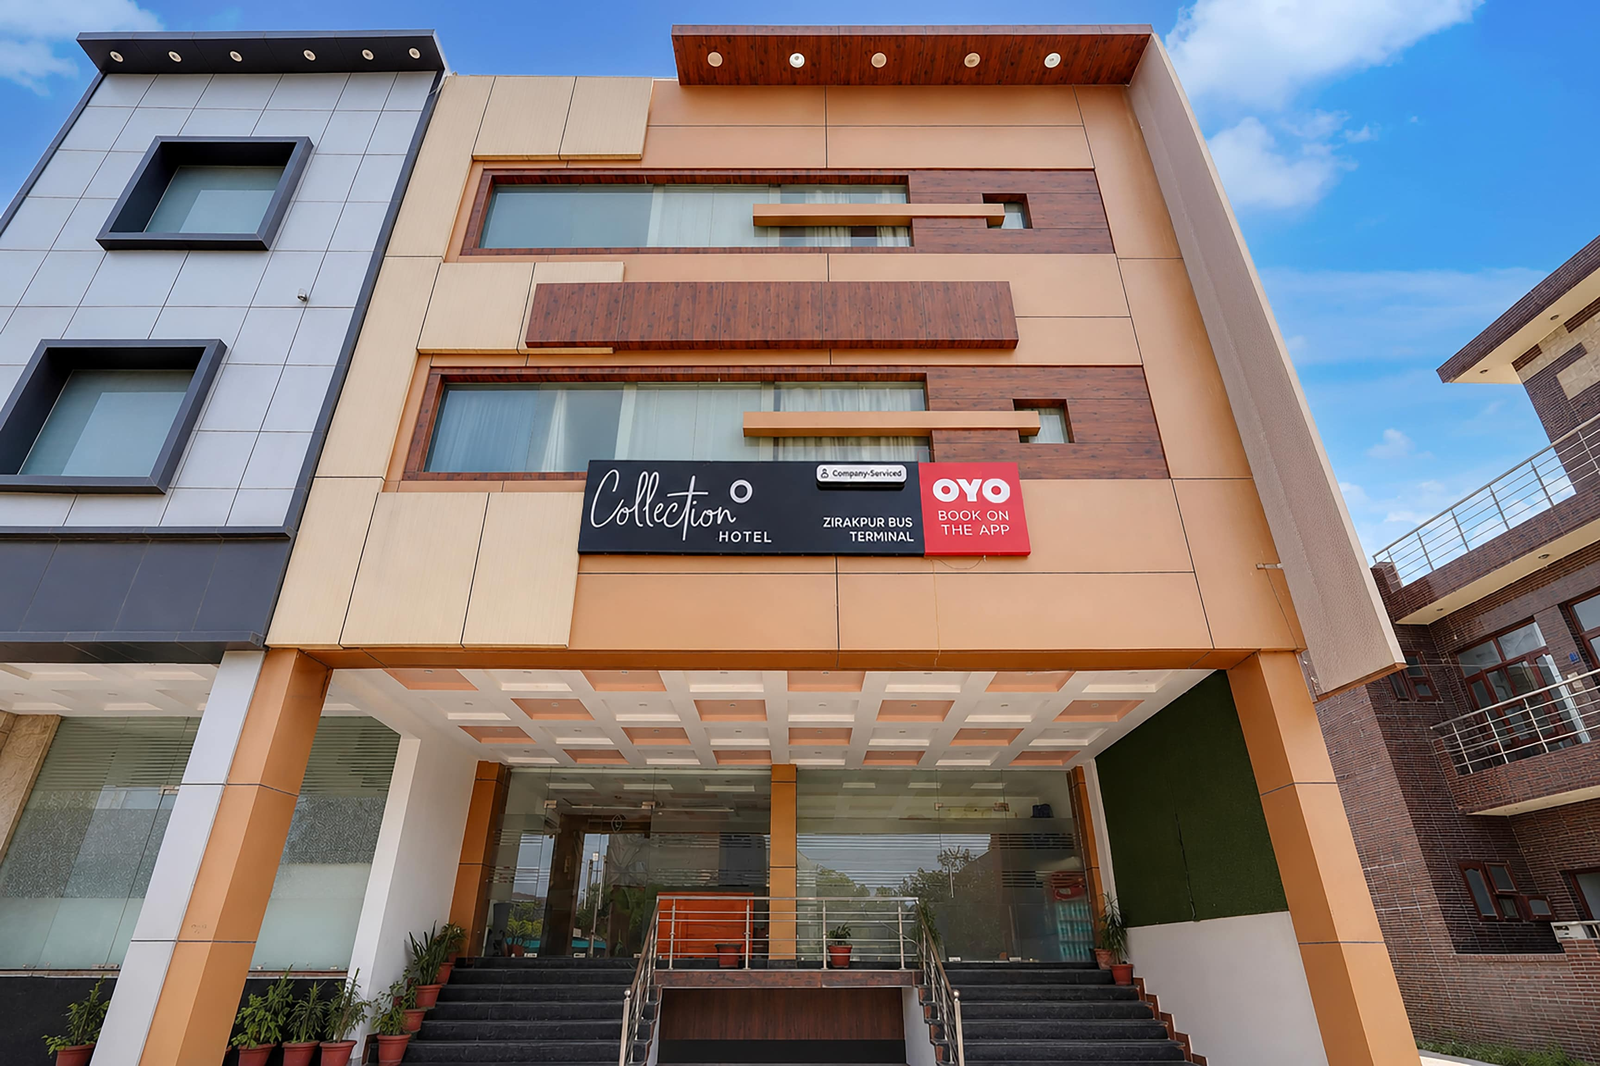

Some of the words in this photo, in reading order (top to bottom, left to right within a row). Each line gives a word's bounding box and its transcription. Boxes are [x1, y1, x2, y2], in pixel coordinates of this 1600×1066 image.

[832, 468, 902, 480] Company-Serviced
[933, 478, 1011, 504] OYO
[591, 469, 737, 541] Collection
[822, 516, 885, 529] ZIRAKPUR
[888, 516, 913, 529] BUS
[938, 510, 981, 522] BOOK
[986, 510, 1010, 522] ON
[849, 530, 915, 543] TERMINAL
[940, 524, 974, 536] THE
[979, 524, 1011, 536] APP
[718, 530, 773, 544] HOTEL
